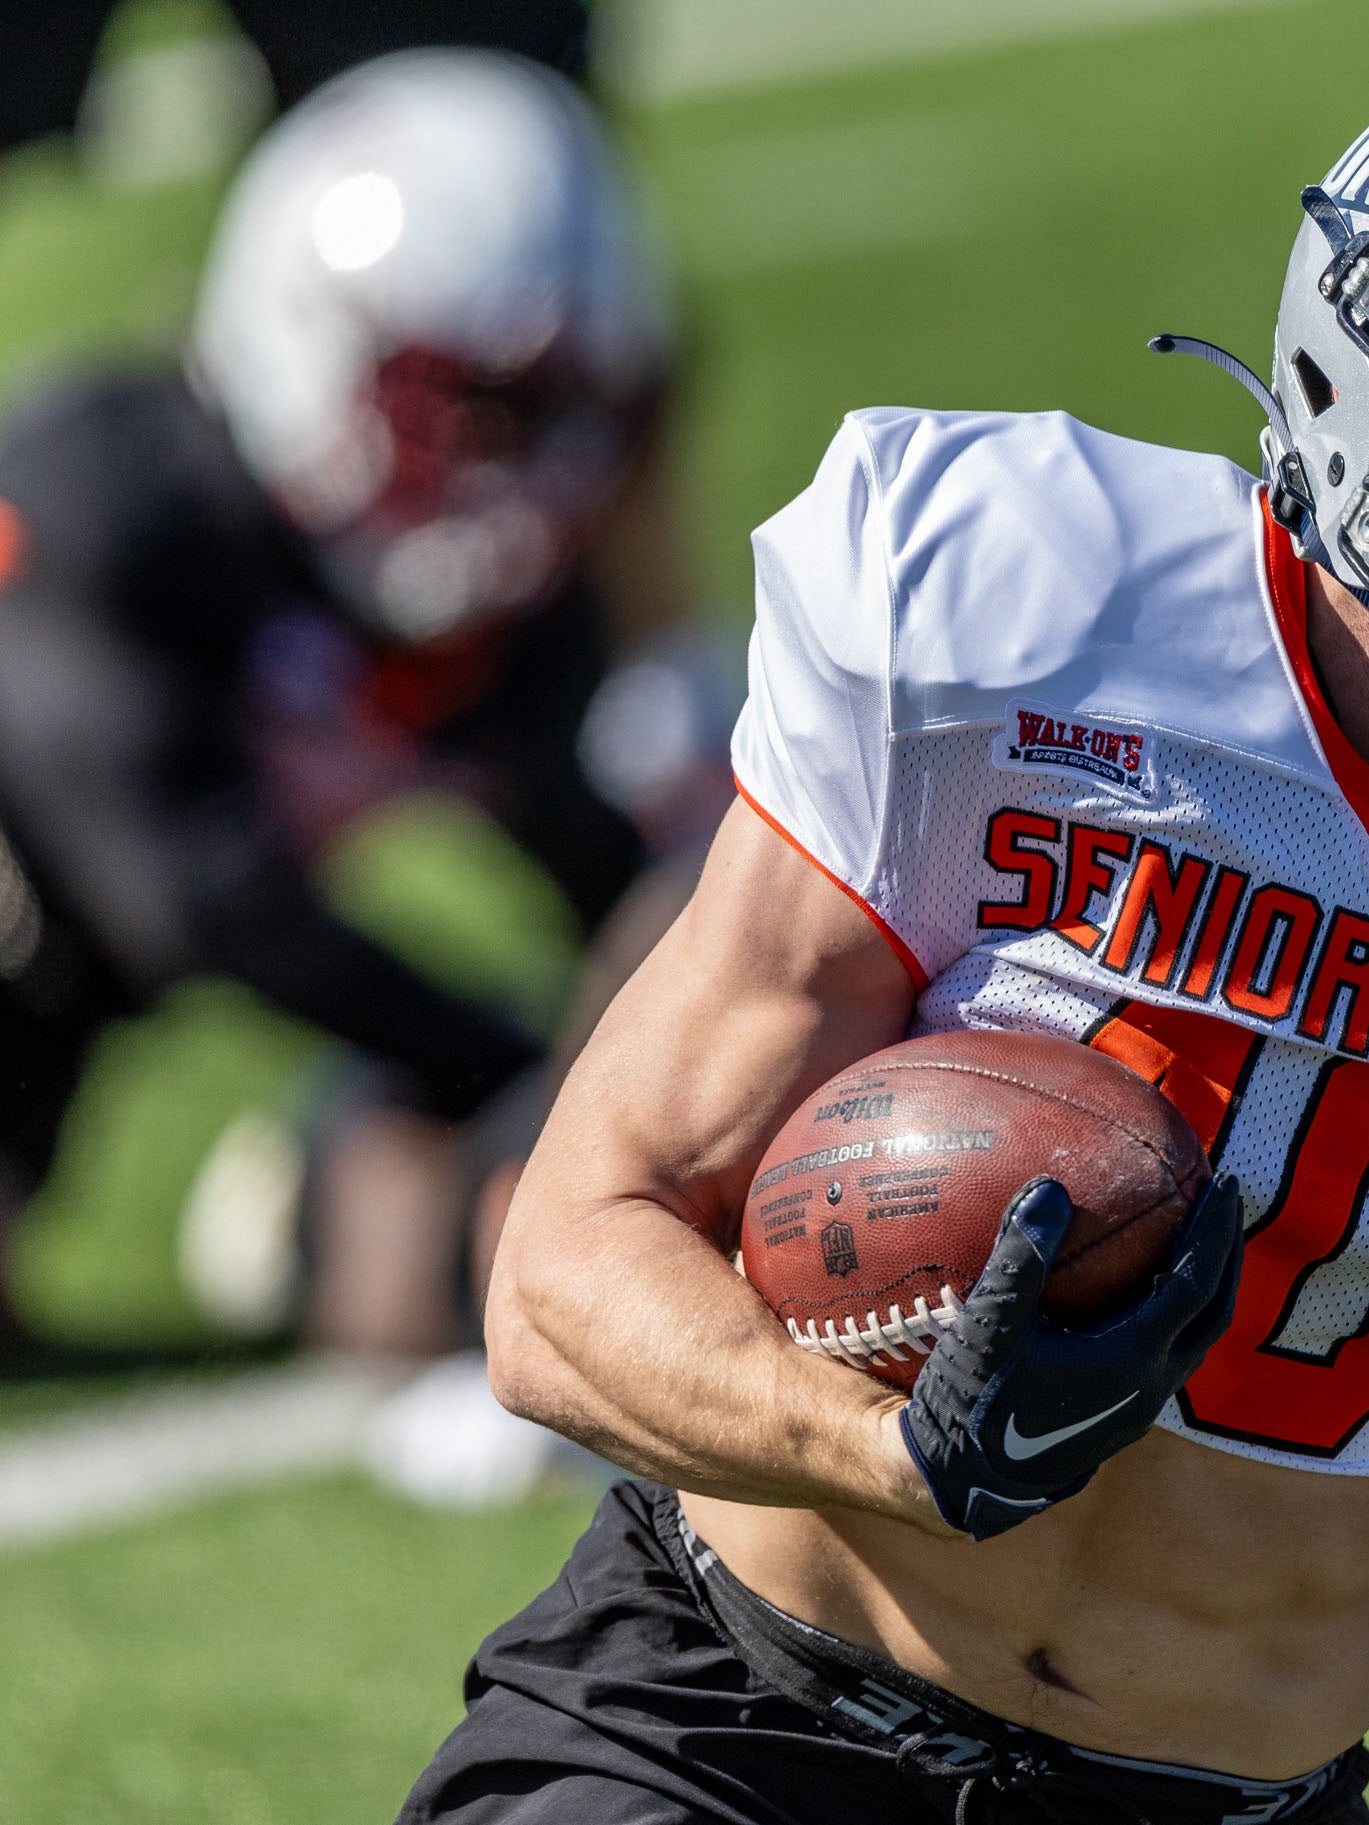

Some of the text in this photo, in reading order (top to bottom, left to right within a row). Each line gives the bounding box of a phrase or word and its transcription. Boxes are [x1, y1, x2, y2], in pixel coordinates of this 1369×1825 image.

[814, 1091, 895, 1123] Wilson
[879, 1130, 994, 1155] NATIONAL
[791, 1139, 875, 1176] FOOTBALL
[867, 1184, 939, 1203] FOOTBALL
[763, 1207, 807, 1232] FOOTBALL
[867, 1201, 940, 1221] AMERICAN
[764, 1224, 807, 1249] NATIONAL
[822, 1223, 852, 1257] NFL
